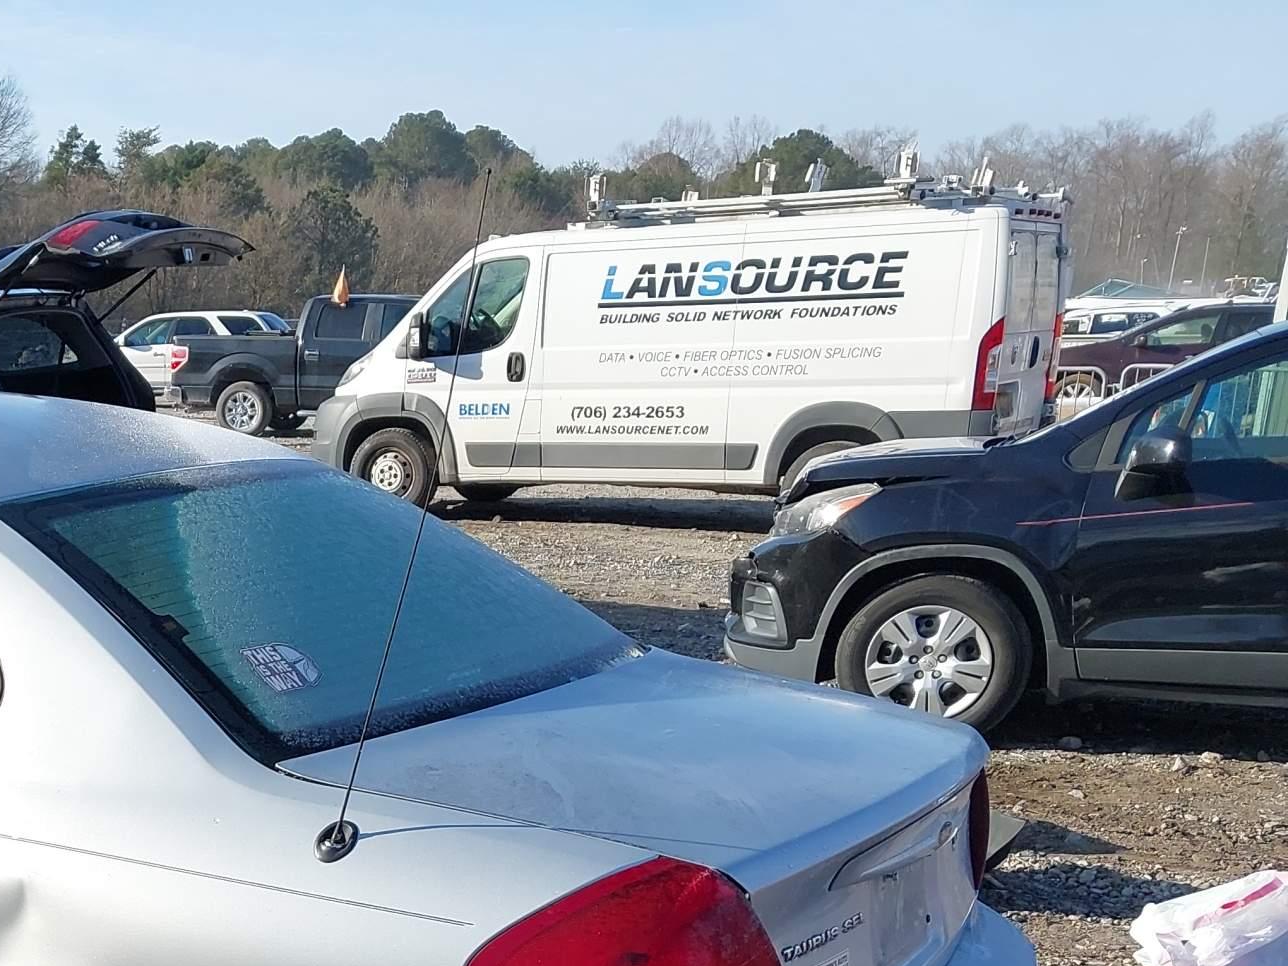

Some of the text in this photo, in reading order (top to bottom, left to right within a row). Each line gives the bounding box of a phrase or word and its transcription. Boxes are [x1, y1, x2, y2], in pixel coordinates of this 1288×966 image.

[601, 251, 909, 300] LANSOURCE
[599, 304, 898, 324] BUILDING SOLID NETWORK FOUNDATIONS
[598, 346, 882, 363] DATA VOICE FIBER OPTICS FUSION SPLICING
[660, 364, 808, 377] CCTV ACCESS CONTROL
[459, 403, 510, 416] BELDEN
[571, 405, 685, 421] (706) 234-2653
[556, 425, 709, 435] WWW.LANSOURCENET.COM
[243, 646, 282, 665] THIS
[256, 660, 292, 676] IS THE
[265, 671, 303, 691] WAY
[781, 926, 839, 963] TAURUS
